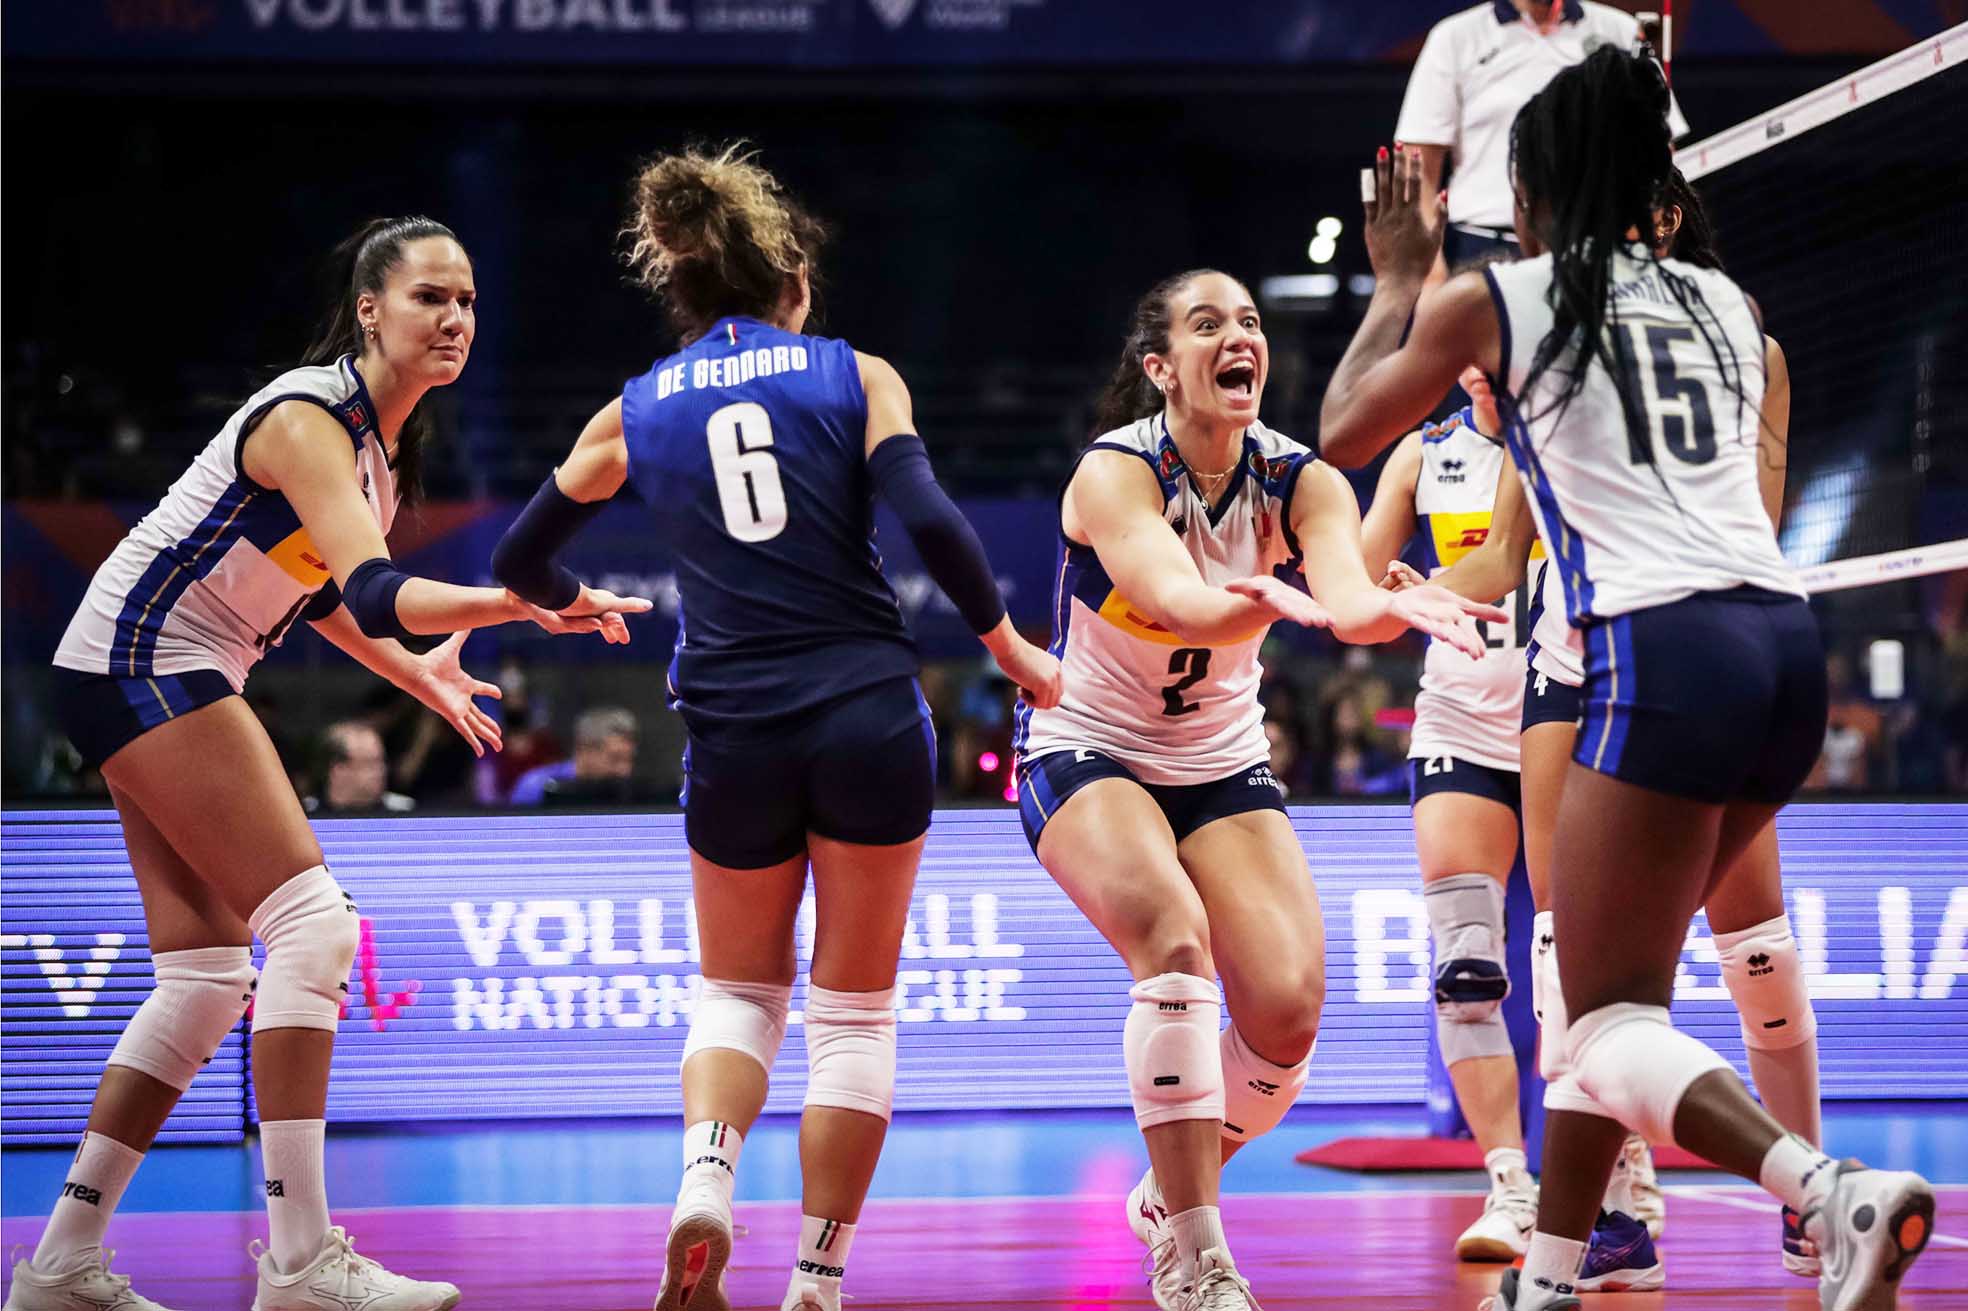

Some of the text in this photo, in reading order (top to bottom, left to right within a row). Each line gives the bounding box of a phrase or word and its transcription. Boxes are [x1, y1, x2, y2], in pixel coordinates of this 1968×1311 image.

[657, 346, 808, 400] DE GENNARO
[1604, 323, 1718, 466] 15
[706, 402, 788, 543] 6
[1161, 648, 1212, 716] 2
[1533, 672, 1549, 696] 4
[1247, 776, 1281, 791] erre
[1248, 1080, 1275, 1096] errea
[800, 1258, 844, 1278] errea
